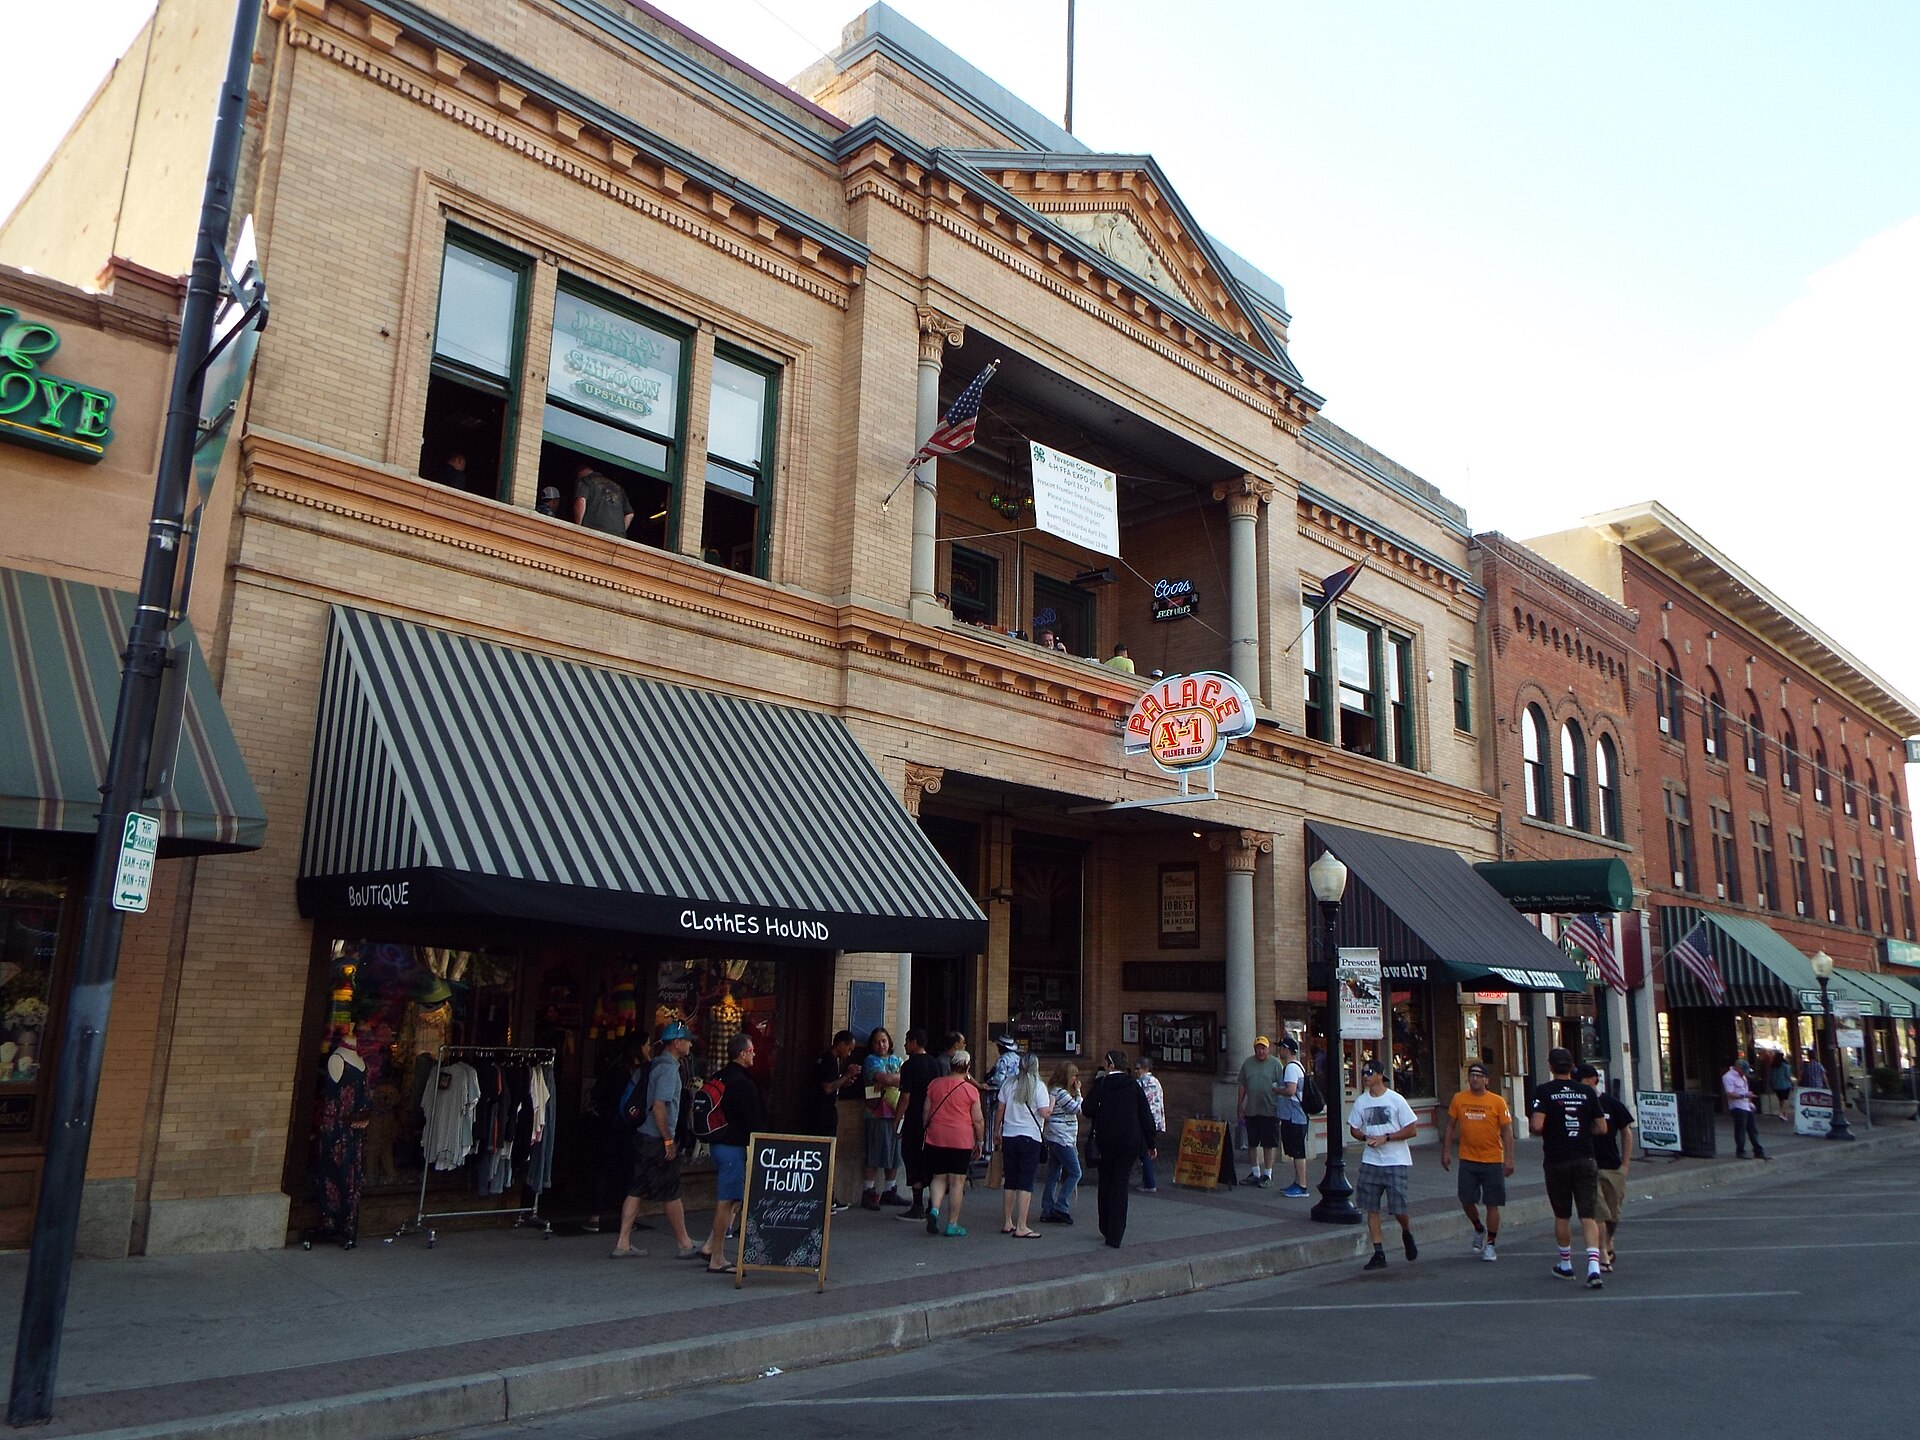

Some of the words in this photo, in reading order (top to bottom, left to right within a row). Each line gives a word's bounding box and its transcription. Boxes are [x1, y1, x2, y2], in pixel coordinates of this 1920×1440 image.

[564, 350, 662, 401] SALOON
[584, 383, 645, 413] UPSTAIRS
[1072, 471, 1088, 483] EXPO
[1075, 463, 1095, 477] County
[1063, 478, 1075, 486] April
[1154, 579, 1191, 598] Coors
[1129, 679, 1240, 736] PALACE
[1155, 717, 1204, 749] A-1
[1162, 747, 1185, 758] PILSNER
[1186, 746, 1202, 755] BEER
[126, 820, 136, 843] 2
[143, 823, 152, 834] HR
[1342, 958, 1377, 967] Prescott
[1380, 963, 1427, 980] ewelry
